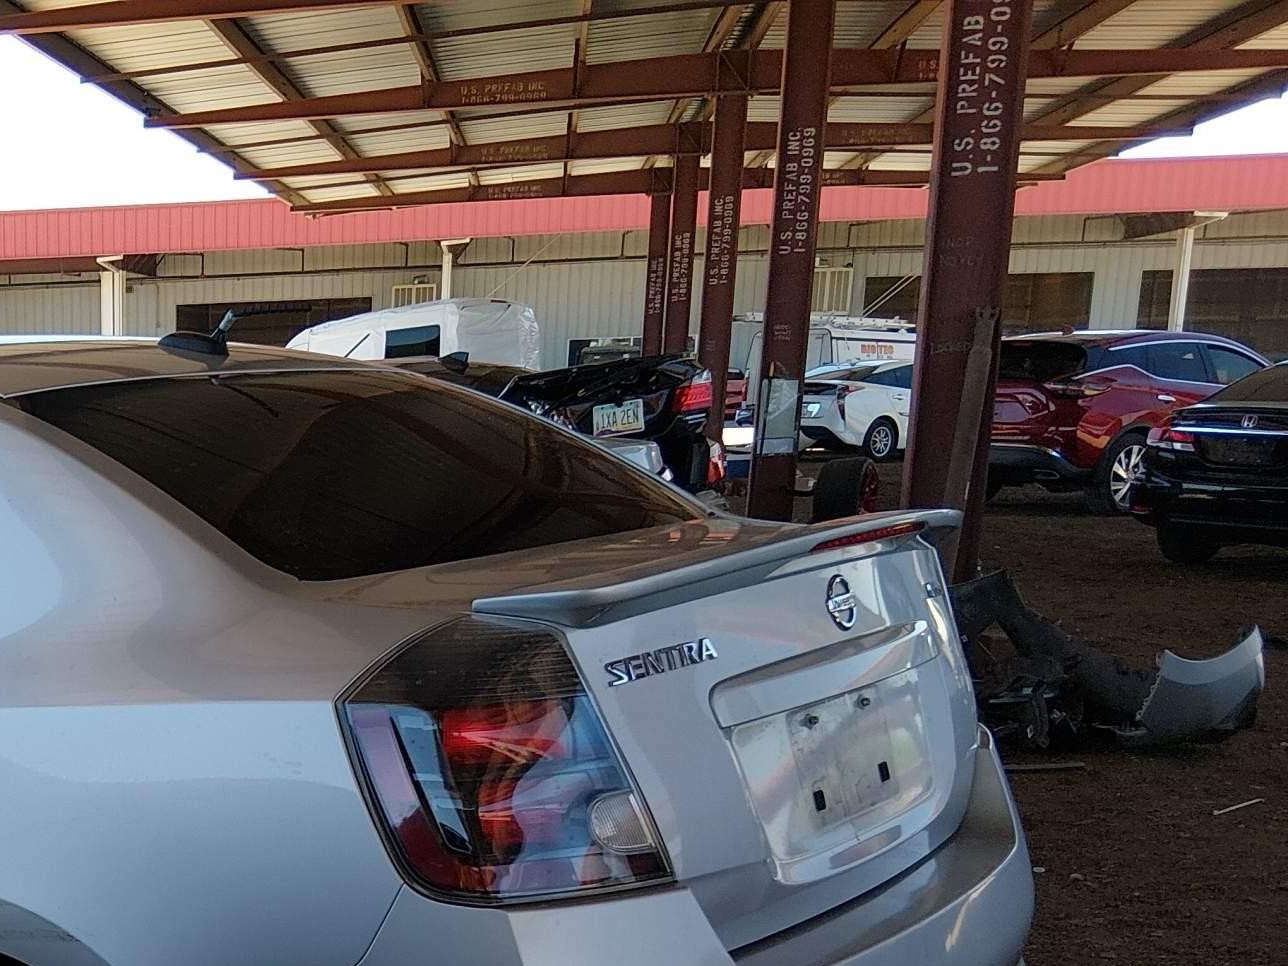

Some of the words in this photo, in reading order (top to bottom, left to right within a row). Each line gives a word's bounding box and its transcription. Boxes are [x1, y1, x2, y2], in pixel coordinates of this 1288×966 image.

[956, 15, 984, 114] PREFAB
[977, 0, 1011, 173] 1-866-799-0
[951, 129, 976, 177] U.S.
[782, 163, 798, 219] PREFAB
[793, 127, 816, 252] 1-866-799-0969
[711, 220, 722, 260] PREFAB
[779, 227, 793, 254] U.S.
[604, 637, 718, 687] SENTRA
